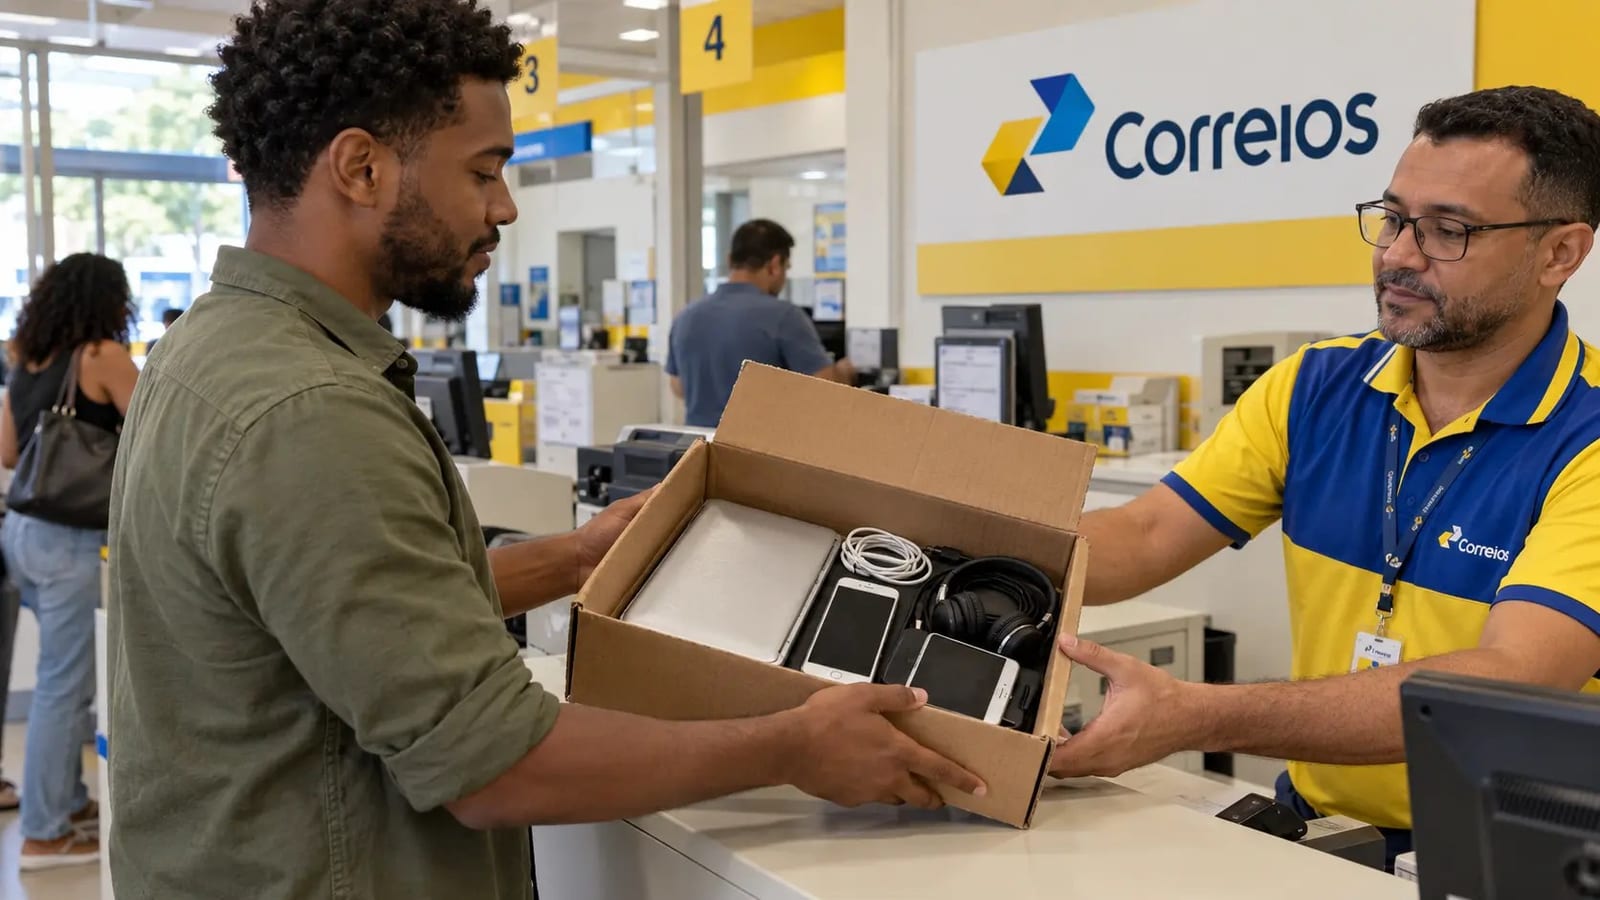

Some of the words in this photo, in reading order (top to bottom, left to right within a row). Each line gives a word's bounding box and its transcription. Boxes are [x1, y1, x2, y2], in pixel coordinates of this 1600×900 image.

[704, 15, 725, 61] 4
[524, 55, 540, 94] 3
[1458, 538, 1510, 562] Correios
